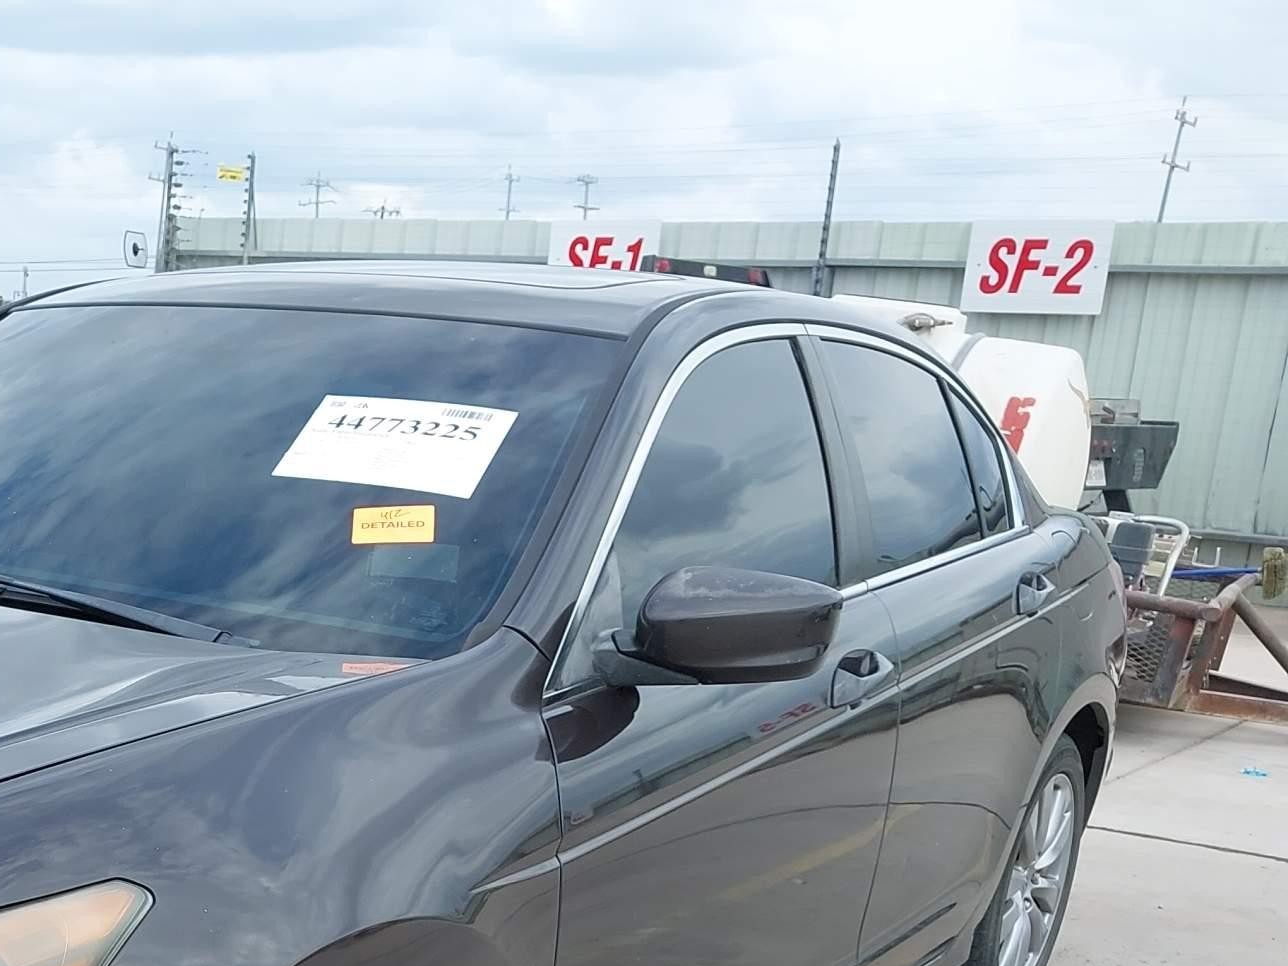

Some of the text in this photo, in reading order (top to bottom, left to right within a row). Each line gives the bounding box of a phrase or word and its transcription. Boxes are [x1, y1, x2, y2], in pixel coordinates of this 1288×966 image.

[979, 238, 1094, 294] SF-2
[327, 413, 483, 442] 44773225
[360, 520, 425, 530] DETAILED
